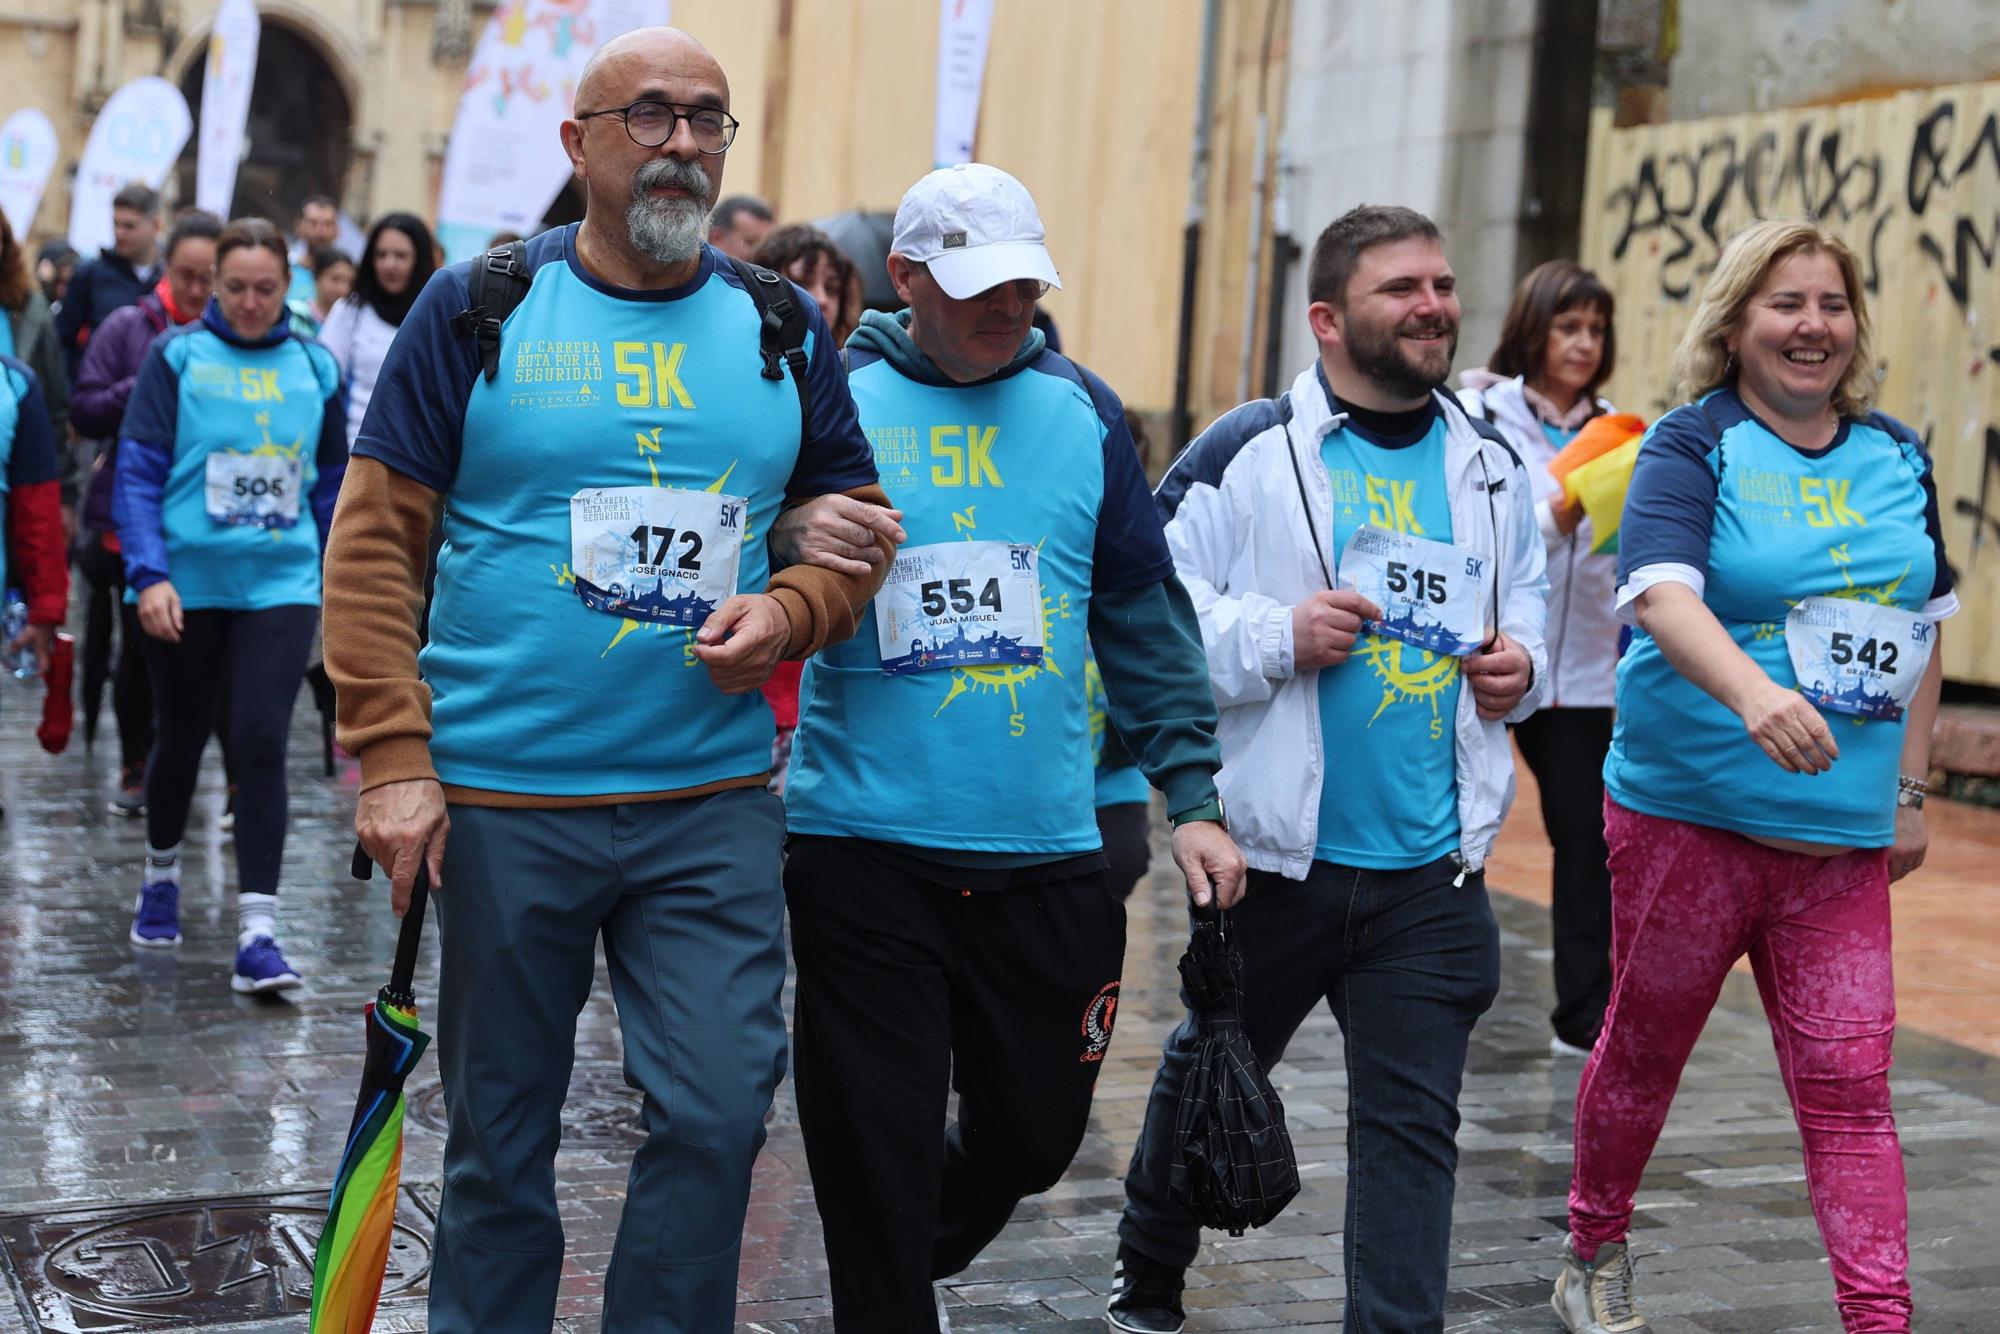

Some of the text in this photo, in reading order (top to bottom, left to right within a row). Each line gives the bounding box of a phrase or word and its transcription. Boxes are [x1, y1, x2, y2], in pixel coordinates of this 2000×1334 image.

[518, 340, 600, 355] IV CARRERA
[517, 353, 600, 368] RUTA POR LA
[239, 367, 285, 403] 5K
[515, 366, 602, 383] SEGURIDAD
[614, 341, 696, 409] 5K
[635, 427, 663, 456] N
[878, 438, 918, 450] POR LA
[931, 425, 1005, 488] 5K
[583, 503, 630, 514] RUTA POR LA
[594, 496, 629, 505] CARRERA
[1366, 473, 1424, 534] 5K
[1800, 477, 1867, 528] 5K
[583, 511, 631, 522] SEGURIDAD
[720, 504, 740, 529] 5K
[952, 505, 976, 533] N
[630, 525, 703, 571] 172
[1830, 543, 1853, 566] N
[900, 565, 913, 575] POR
[914, 563, 923, 573] LA
[1010, 550, 1033, 571] 5K
[1465, 556, 1484, 579] 5K
[629, 565, 699, 580] JOSÉ IGNACIO
[1387, 561, 1447, 604] 515
[921, 577, 1002, 617] 554
[1400, 596, 1431, 610] DANIEL
[929, 614, 999, 627] JUAN MIGUEL
[1912, 621, 1932, 643] 5K
[1831, 632, 1899, 675] 542
[1010, 712, 1025, 737] S
[1430, 717, 1442, 739] S
